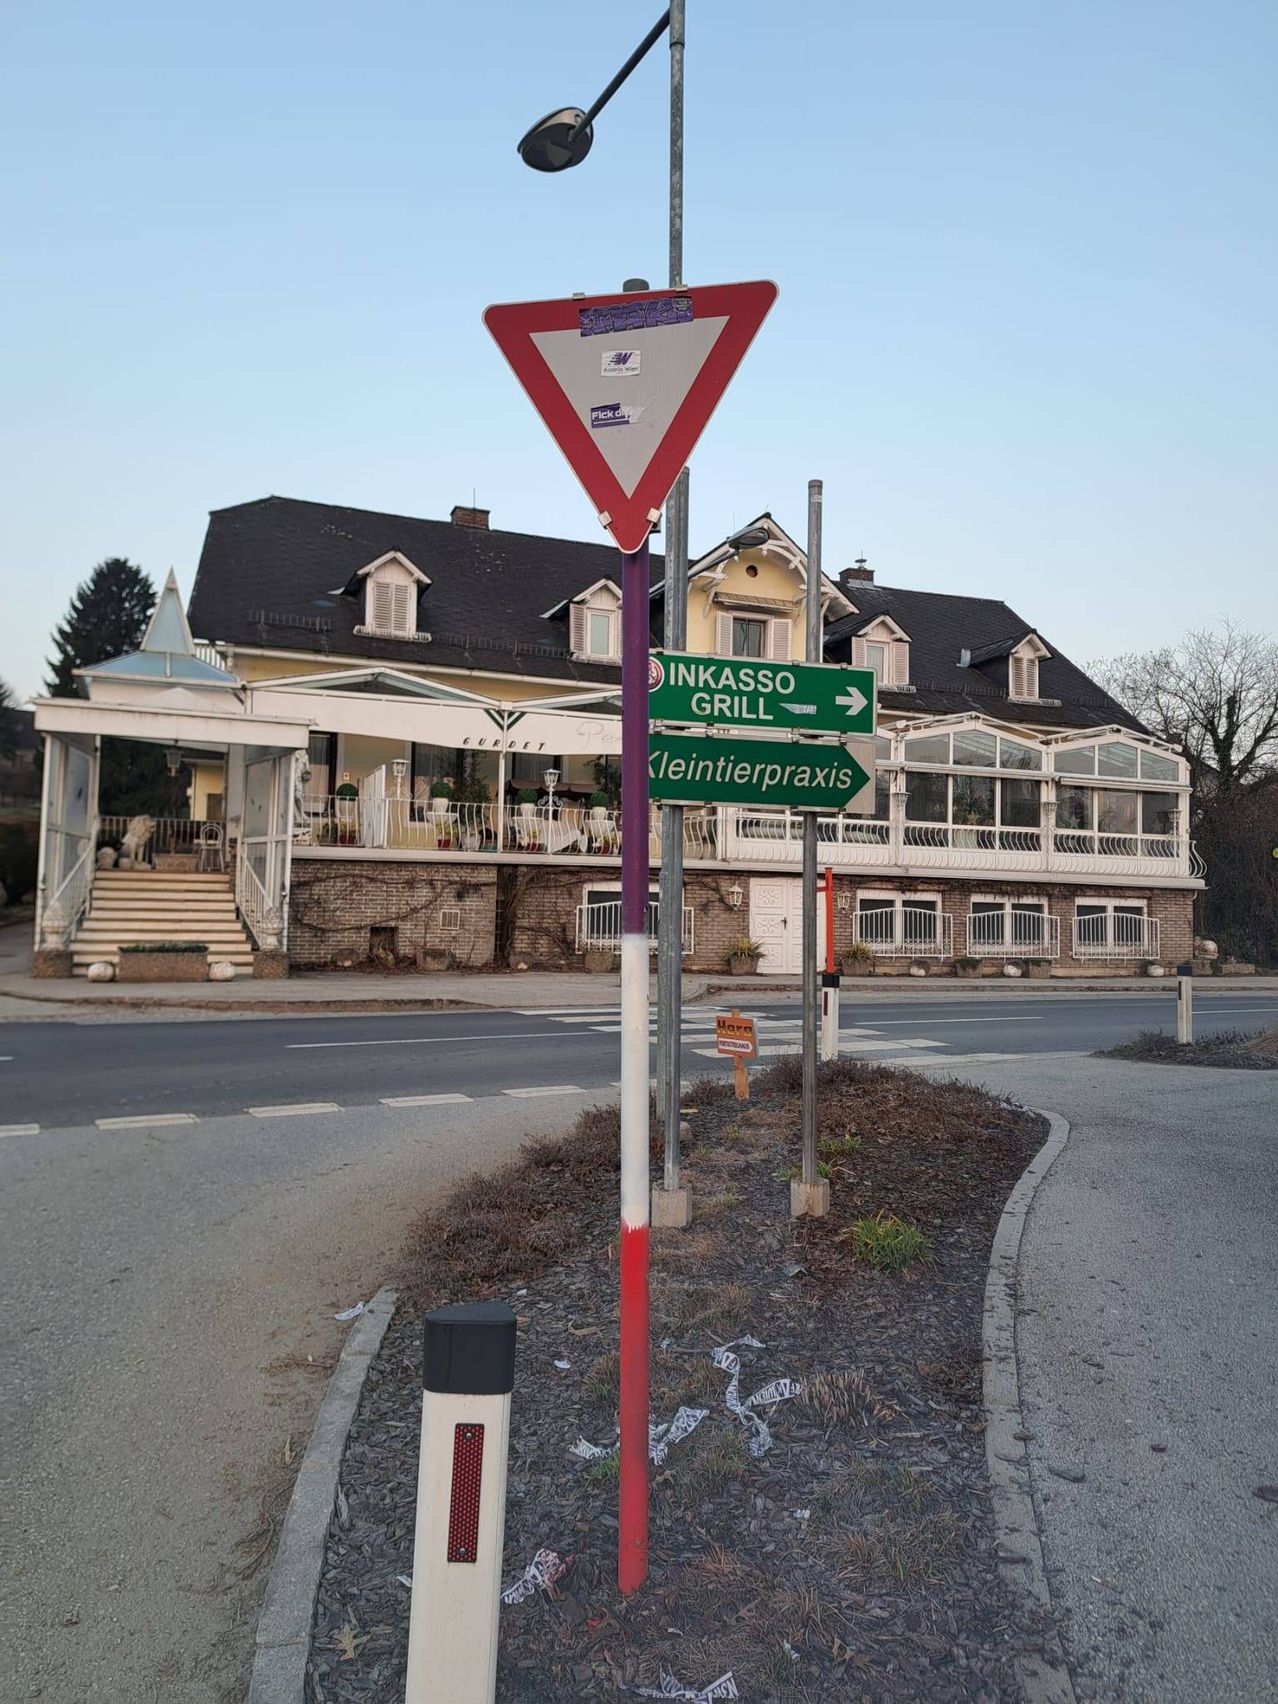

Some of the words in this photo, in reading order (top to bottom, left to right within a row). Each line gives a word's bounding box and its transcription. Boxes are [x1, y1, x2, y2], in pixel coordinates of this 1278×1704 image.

[669, 662, 796, 695] INKASSO
[691, 692, 774, 721] GRILL
[462, 736, 547, 751] GURDET
